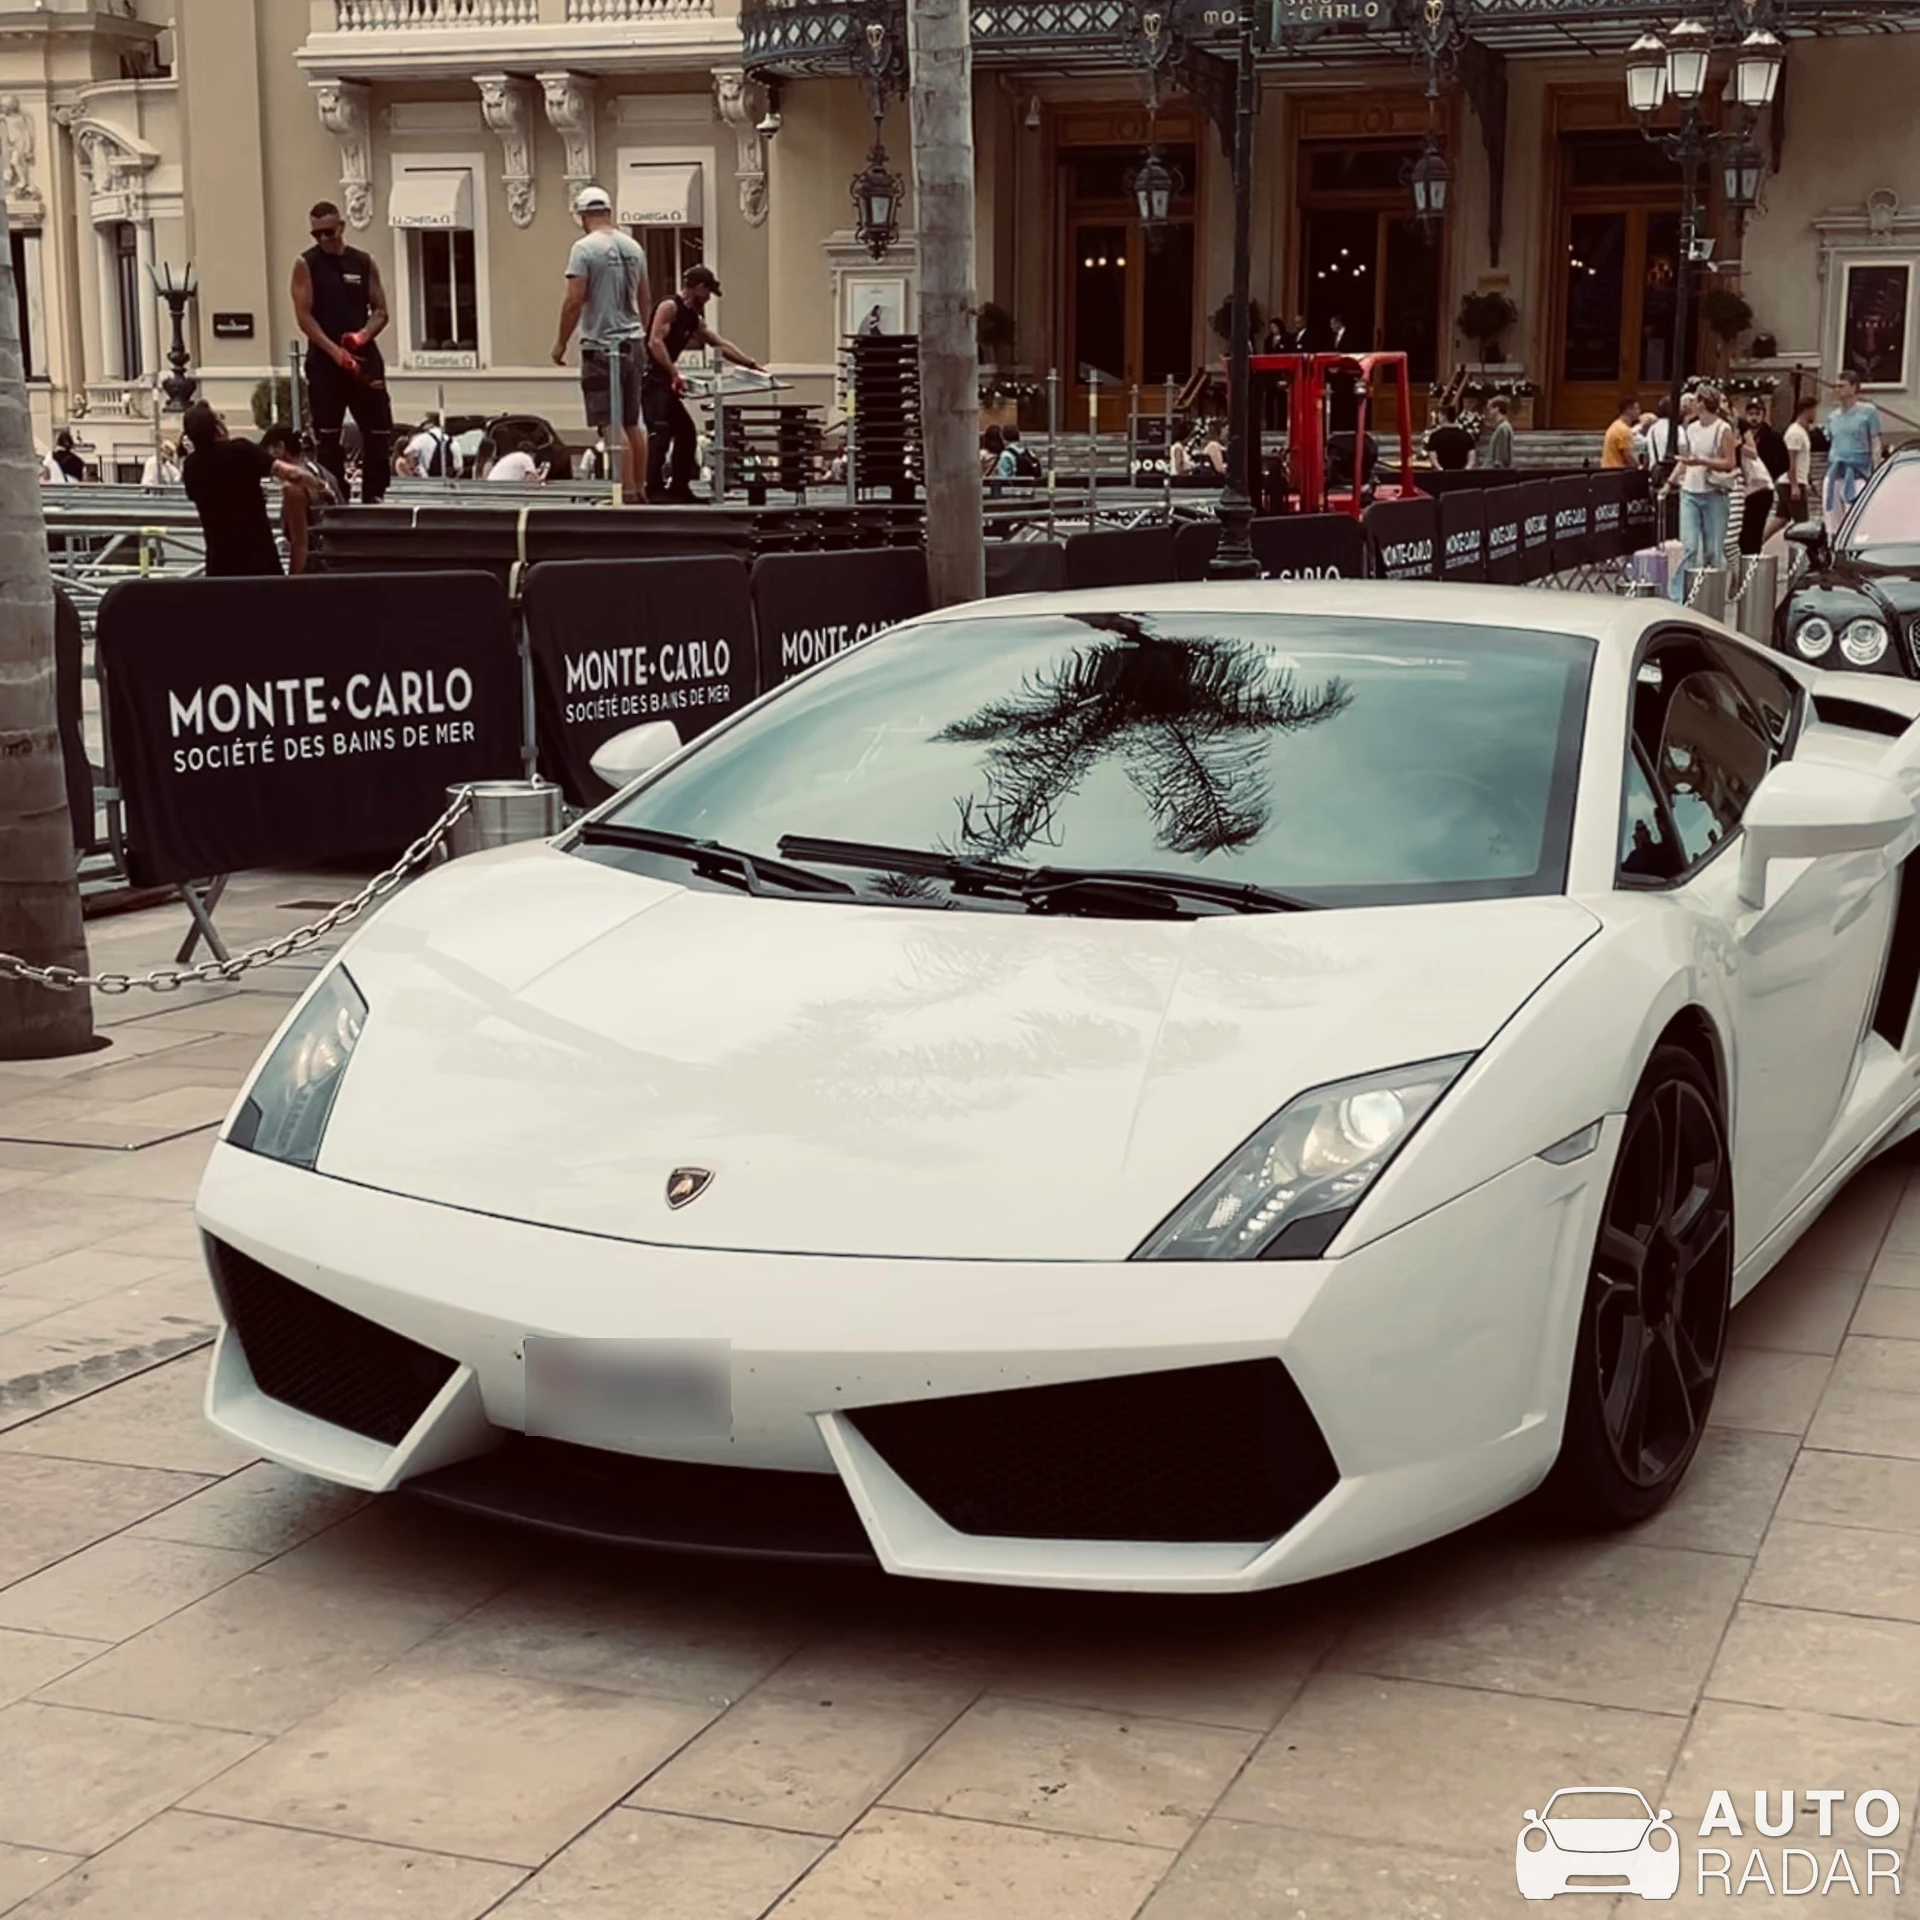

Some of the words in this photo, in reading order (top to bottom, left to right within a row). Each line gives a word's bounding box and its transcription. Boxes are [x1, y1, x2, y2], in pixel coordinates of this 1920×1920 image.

[565, 694, 619, 723] SOCIÉTÉ
[621, 694, 648, 715] DES
[650, 689, 688, 712] BAINS
[690, 687, 705, 706] DE
[707, 684, 731, 704] MER
[173, 734, 275, 773] SOCIÉTÉ
[283, 735, 326, 761] DES
[332, 727, 396, 755] BAINS
[402, 724, 430, 748] DE
[435, 720, 475, 744] MER
